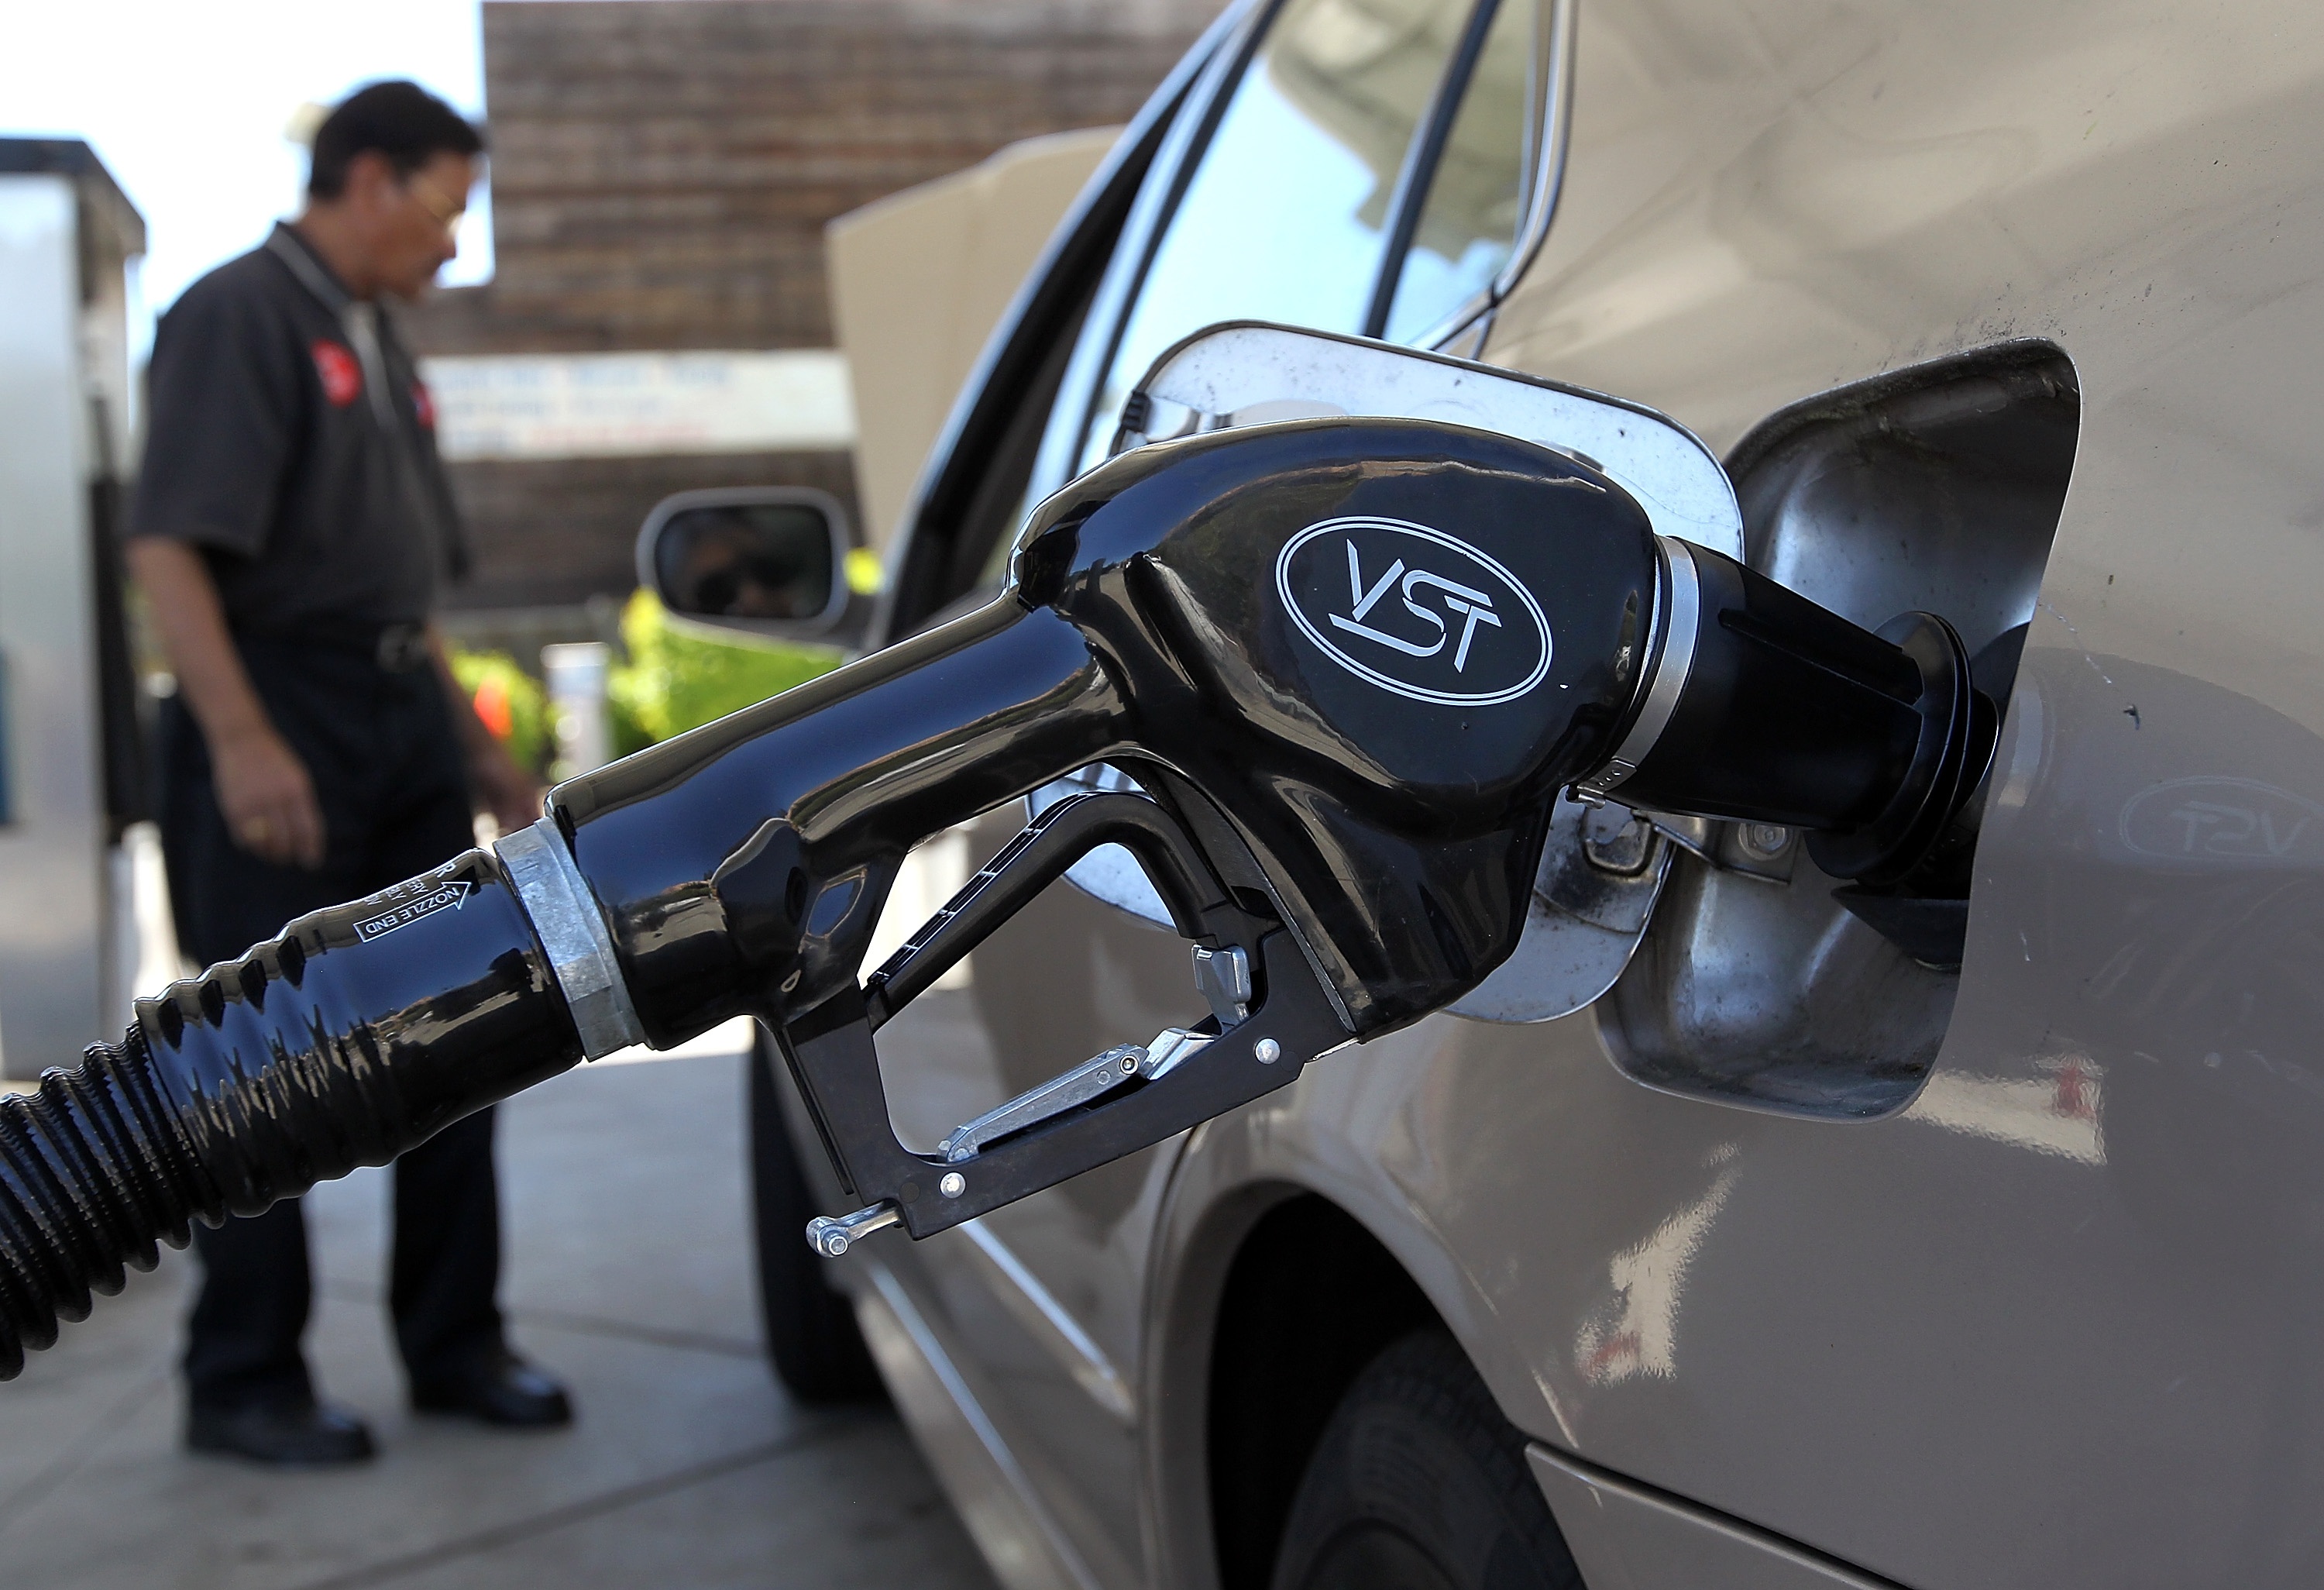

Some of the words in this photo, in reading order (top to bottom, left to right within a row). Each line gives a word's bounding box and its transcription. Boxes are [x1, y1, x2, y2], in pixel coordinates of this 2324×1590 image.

[1329, 539, 1502, 673] VST
[398, 886, 461, 921] NOZZLE
[365, 915, 400, 934] END
